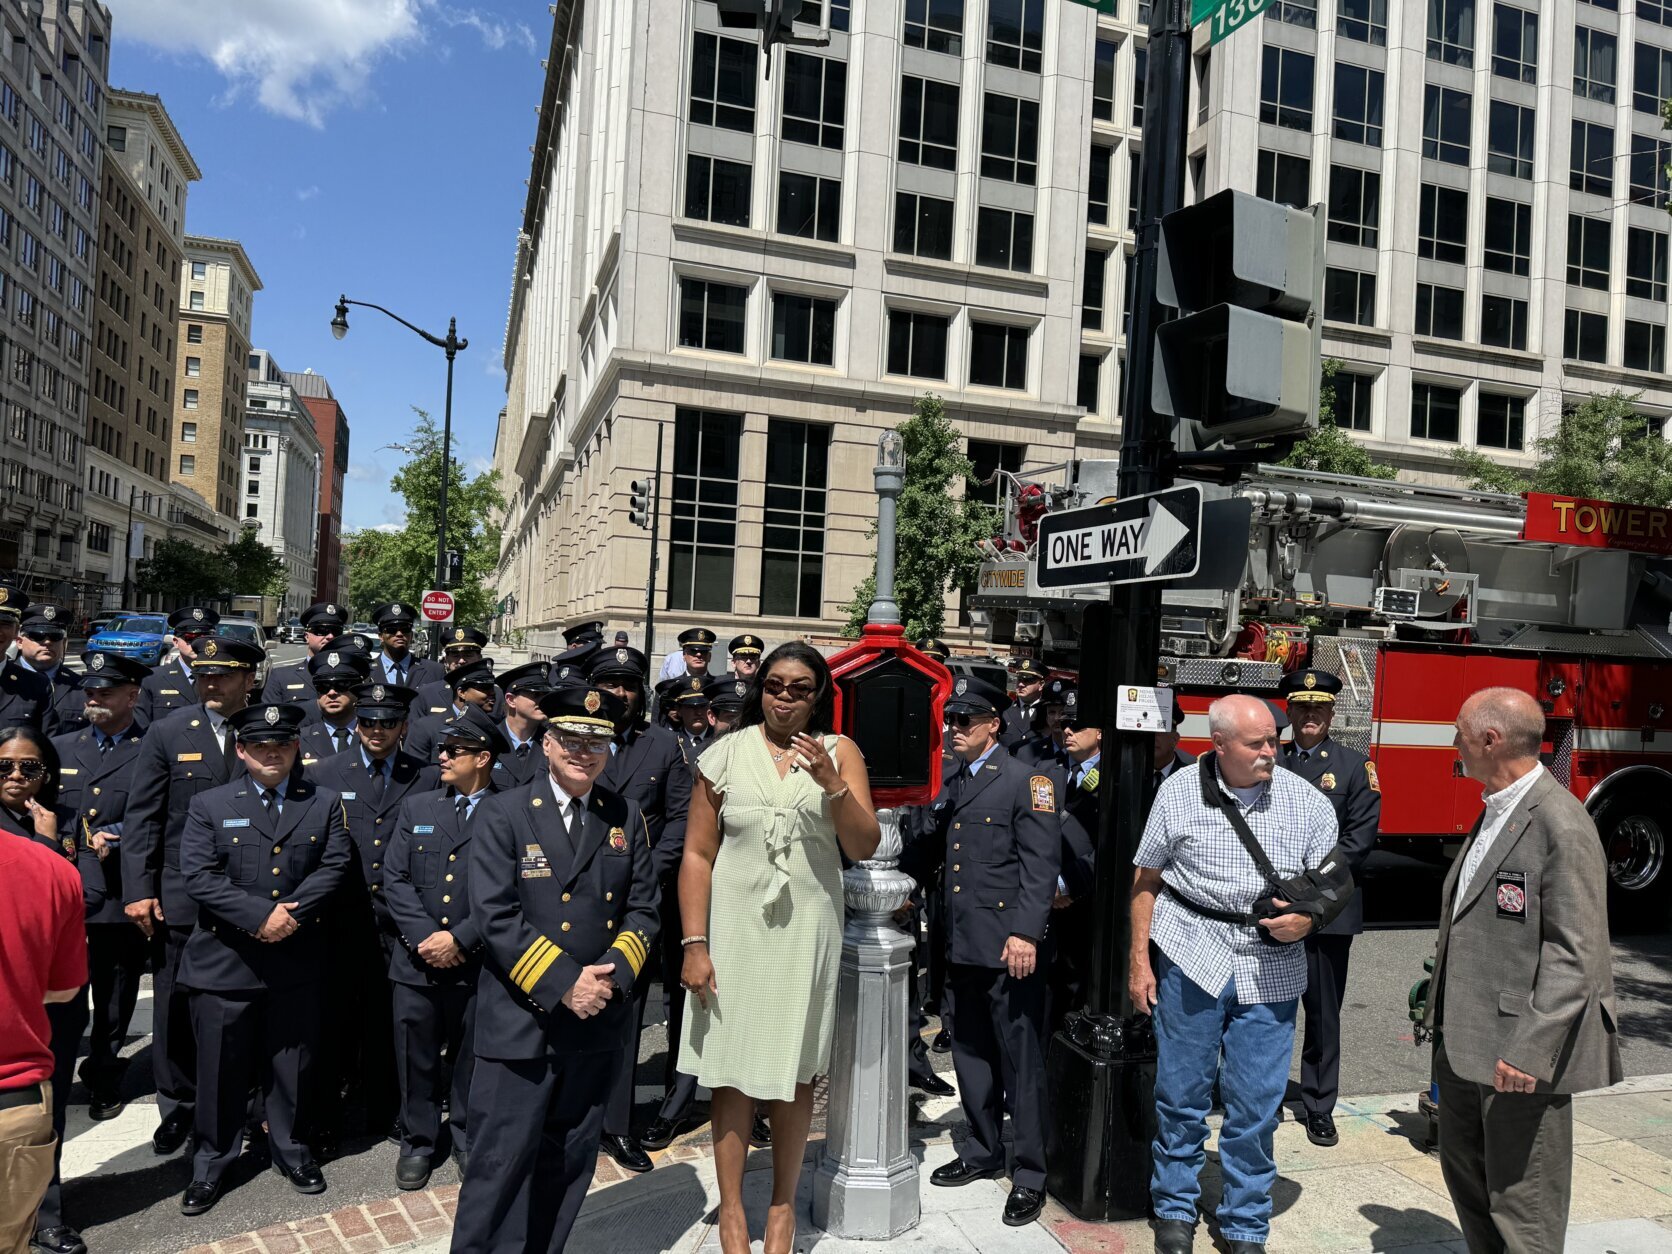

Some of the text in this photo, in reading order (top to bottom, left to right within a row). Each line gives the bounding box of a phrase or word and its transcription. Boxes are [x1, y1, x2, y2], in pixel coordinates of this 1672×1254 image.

[1552, 500, 1668, 538] TOWER
[1052, 522, 1145, 564] ONE WAY
[981, 569, 1025, 588] CITYWIDE
